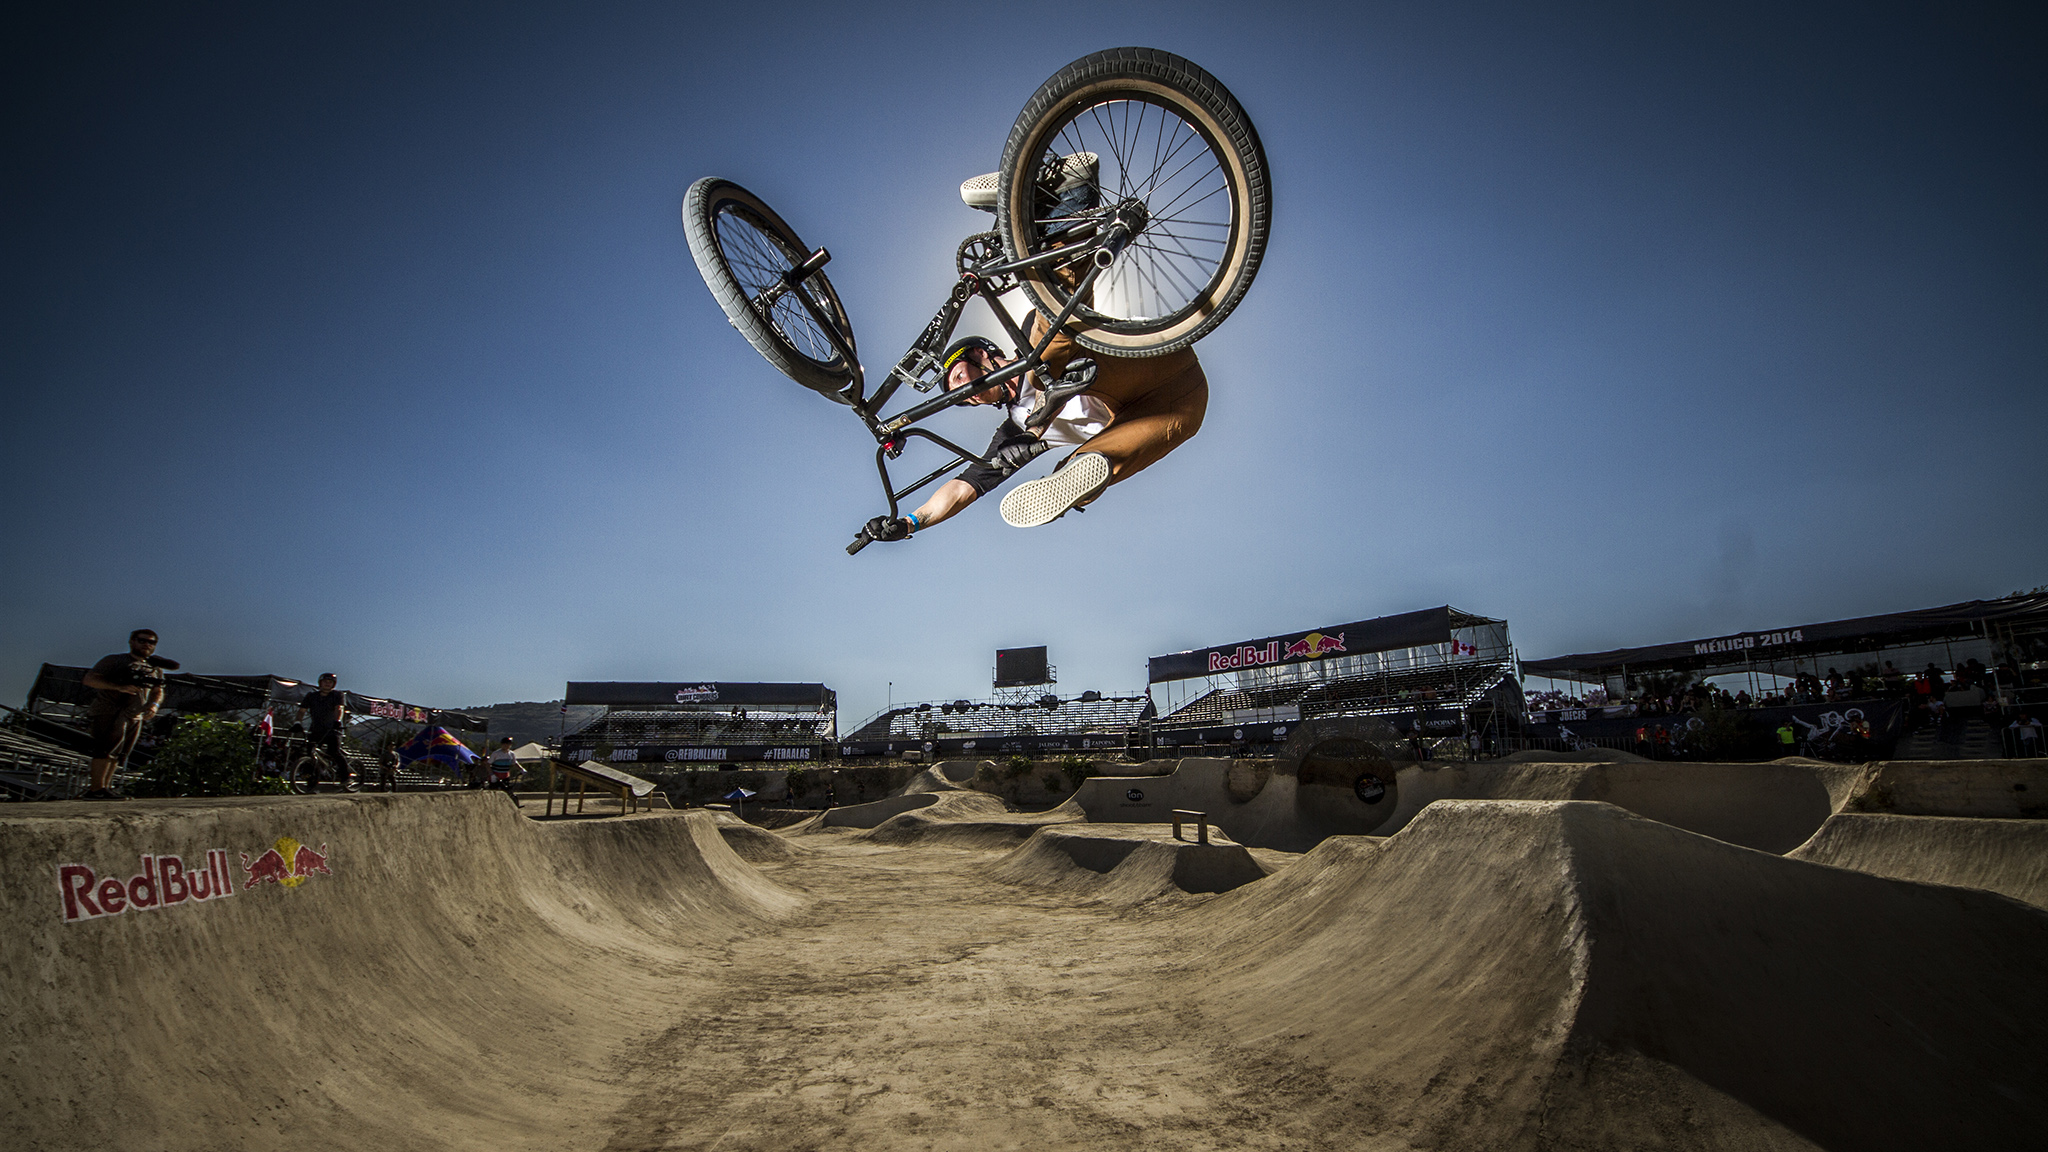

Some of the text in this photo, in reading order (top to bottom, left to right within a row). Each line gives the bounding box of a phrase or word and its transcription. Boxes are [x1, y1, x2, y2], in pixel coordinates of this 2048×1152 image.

[1694, 630, 1803, 655] MÉXICO 2014
[1560, 710, 1587, 721] JUECES
[567, 749, 639, 762] #DIRQUERS
[1127, 790, 1143, 799] ion
